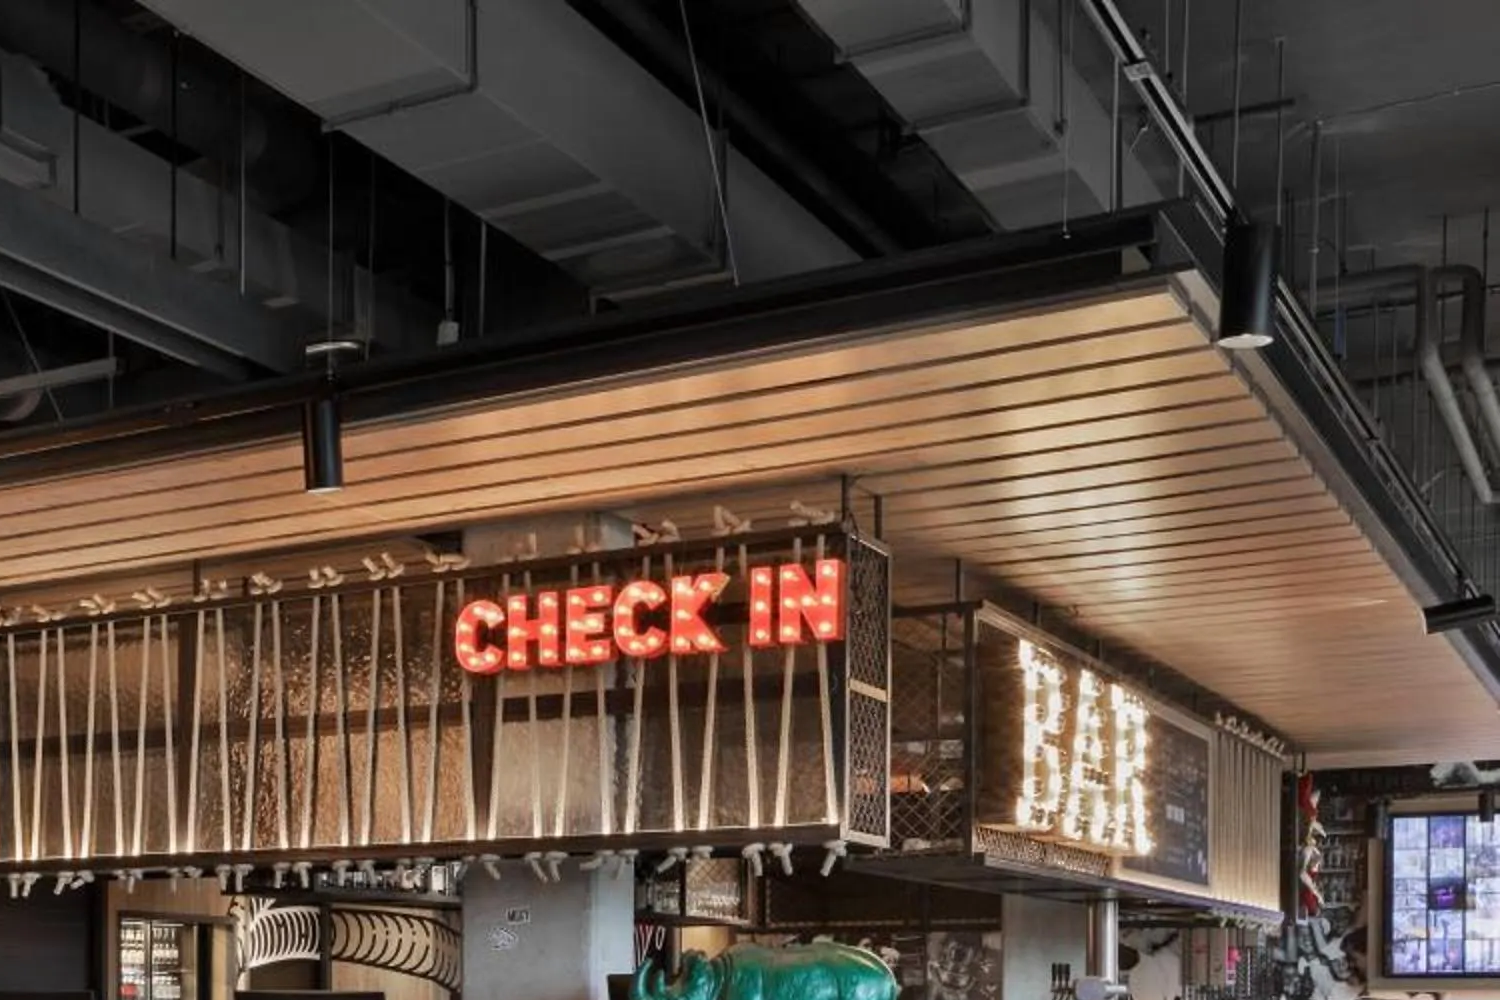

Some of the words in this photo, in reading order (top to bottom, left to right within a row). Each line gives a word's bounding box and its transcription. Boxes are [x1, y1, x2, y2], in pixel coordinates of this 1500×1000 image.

[455, 572, 731, 675] CHECK
[749, 559, 847, 647] IN
[1016, 638, 1155, 856] BAR
